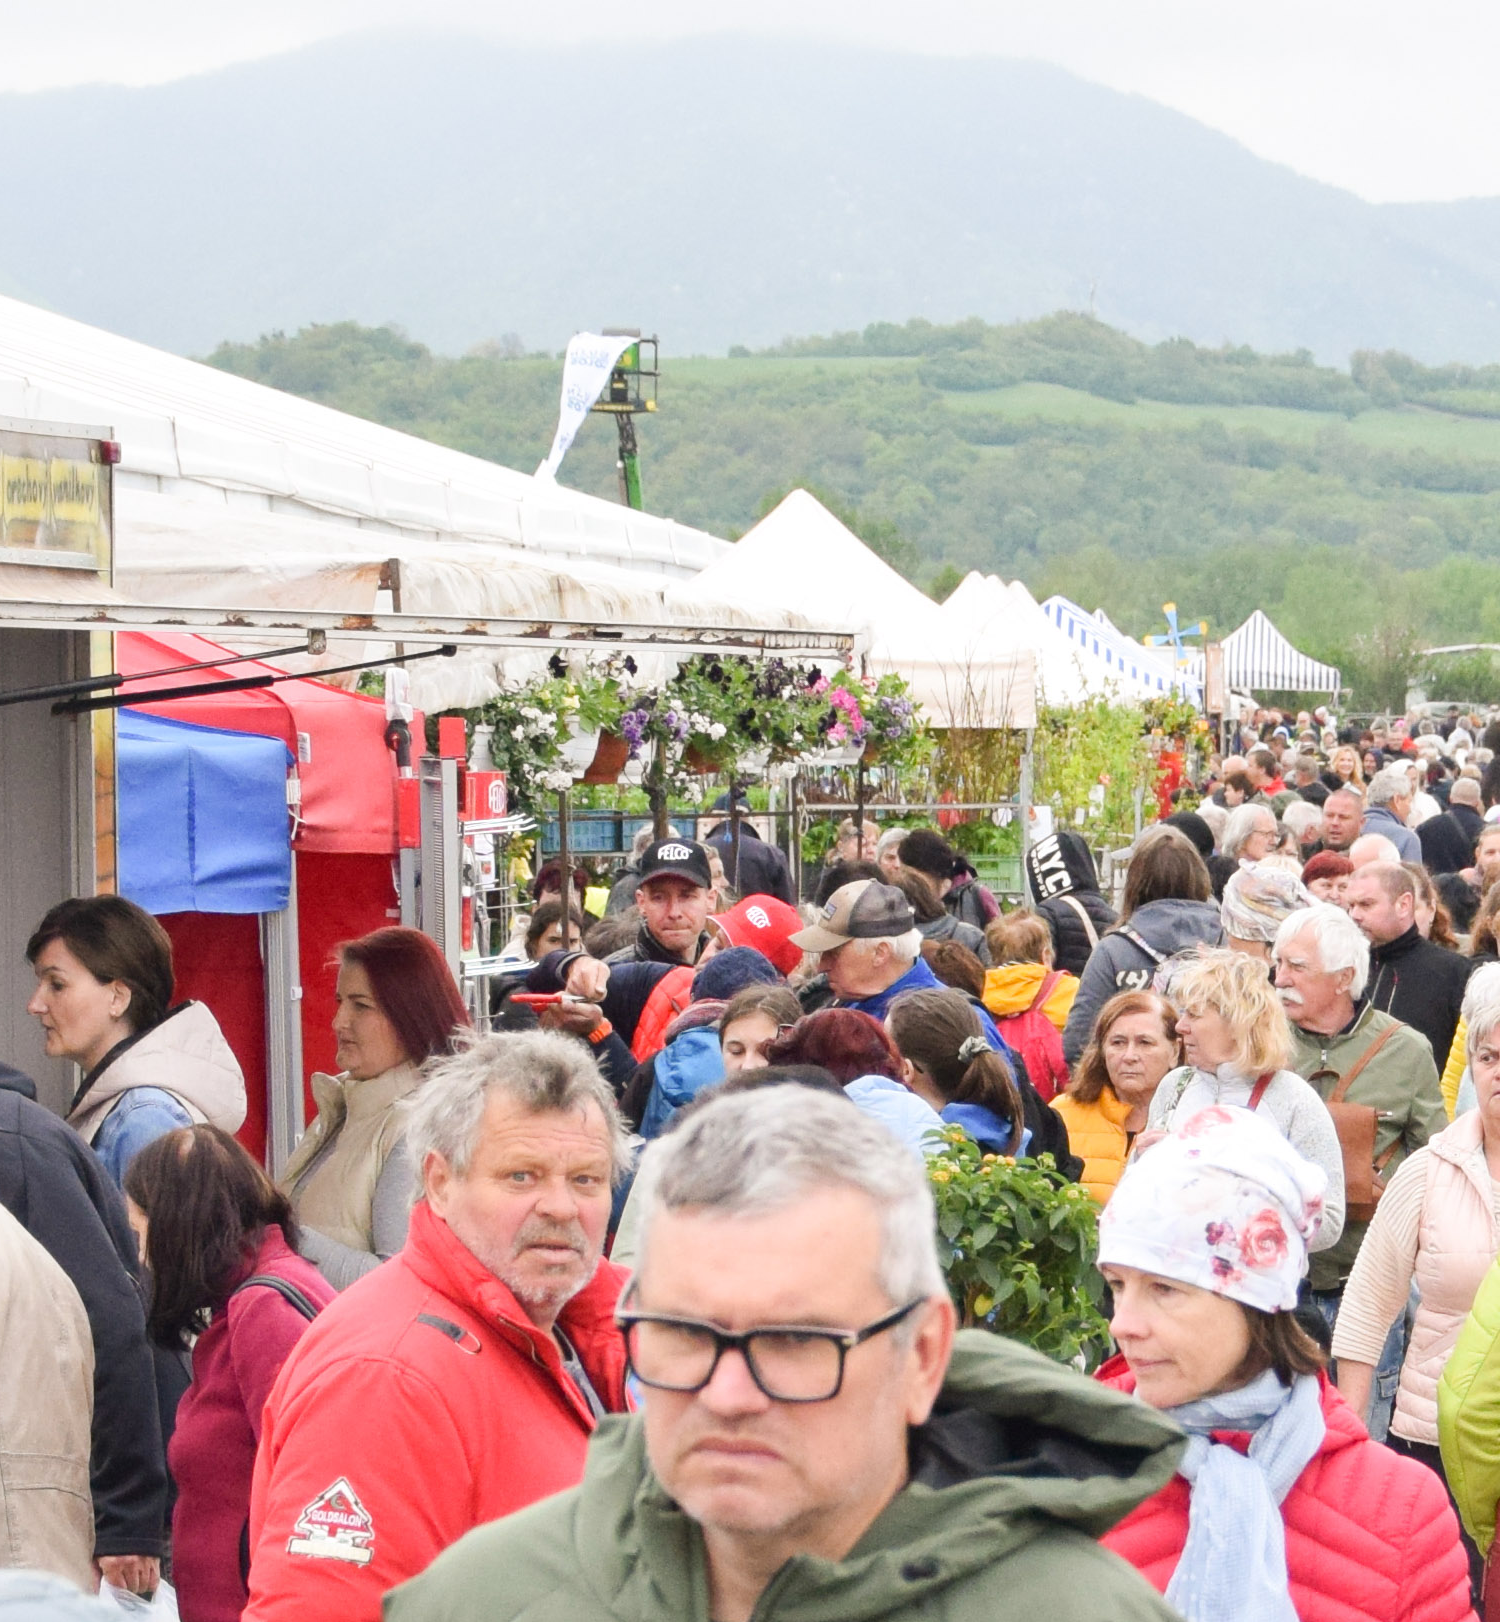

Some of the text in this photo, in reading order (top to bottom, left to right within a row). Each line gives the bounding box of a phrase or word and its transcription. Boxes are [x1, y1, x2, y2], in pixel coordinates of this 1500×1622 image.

[657, 843, 694, 860] FELCO
[1036, 834, 1072, 893] NYC
[745, 904, 771, 929] FELCO
[311, 1510, 364, 1528] GOLDSALON
